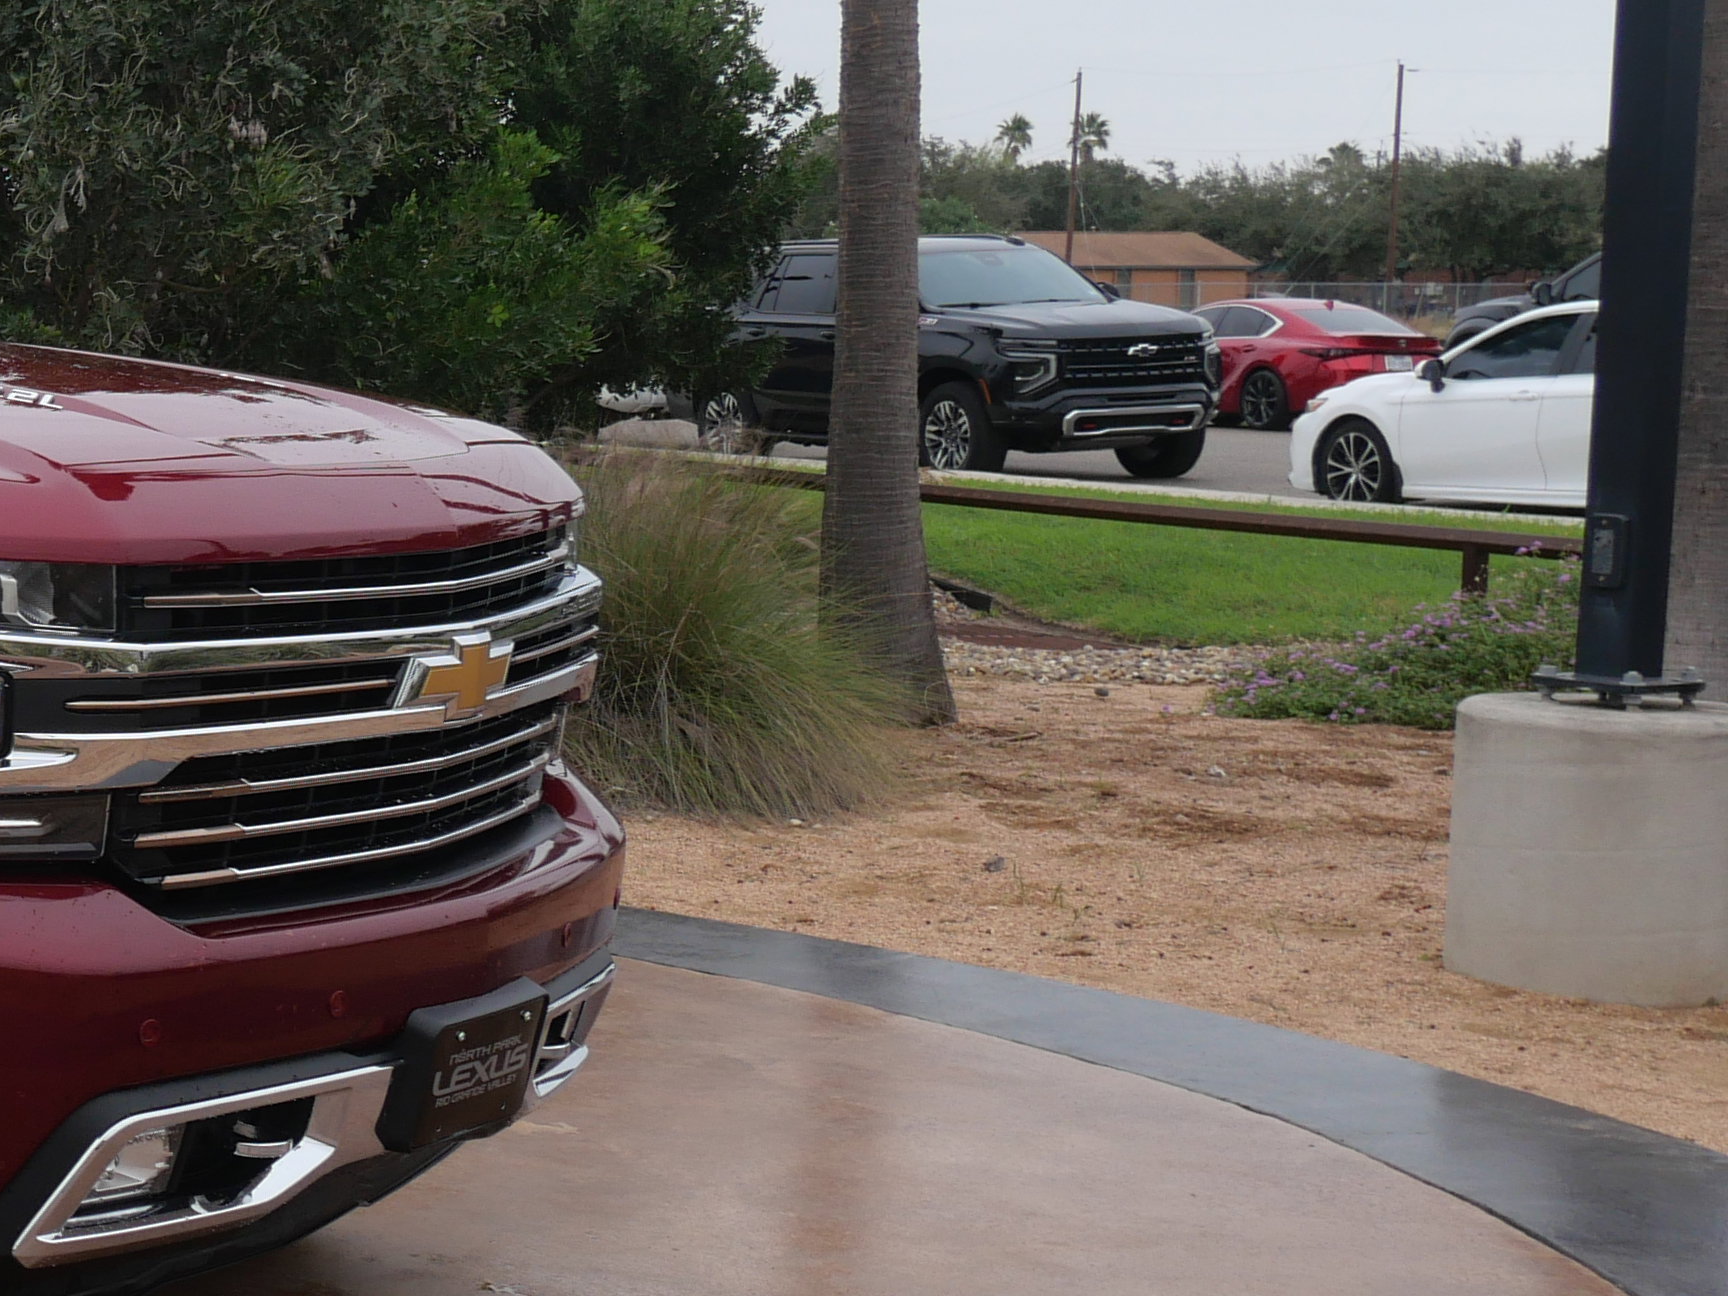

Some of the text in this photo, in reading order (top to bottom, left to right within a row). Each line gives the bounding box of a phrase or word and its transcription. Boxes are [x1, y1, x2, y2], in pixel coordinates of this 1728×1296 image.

[432, 1043, 529, 1097] LEXUS
[449, 1034, 522, 1066] NORTH PARK
